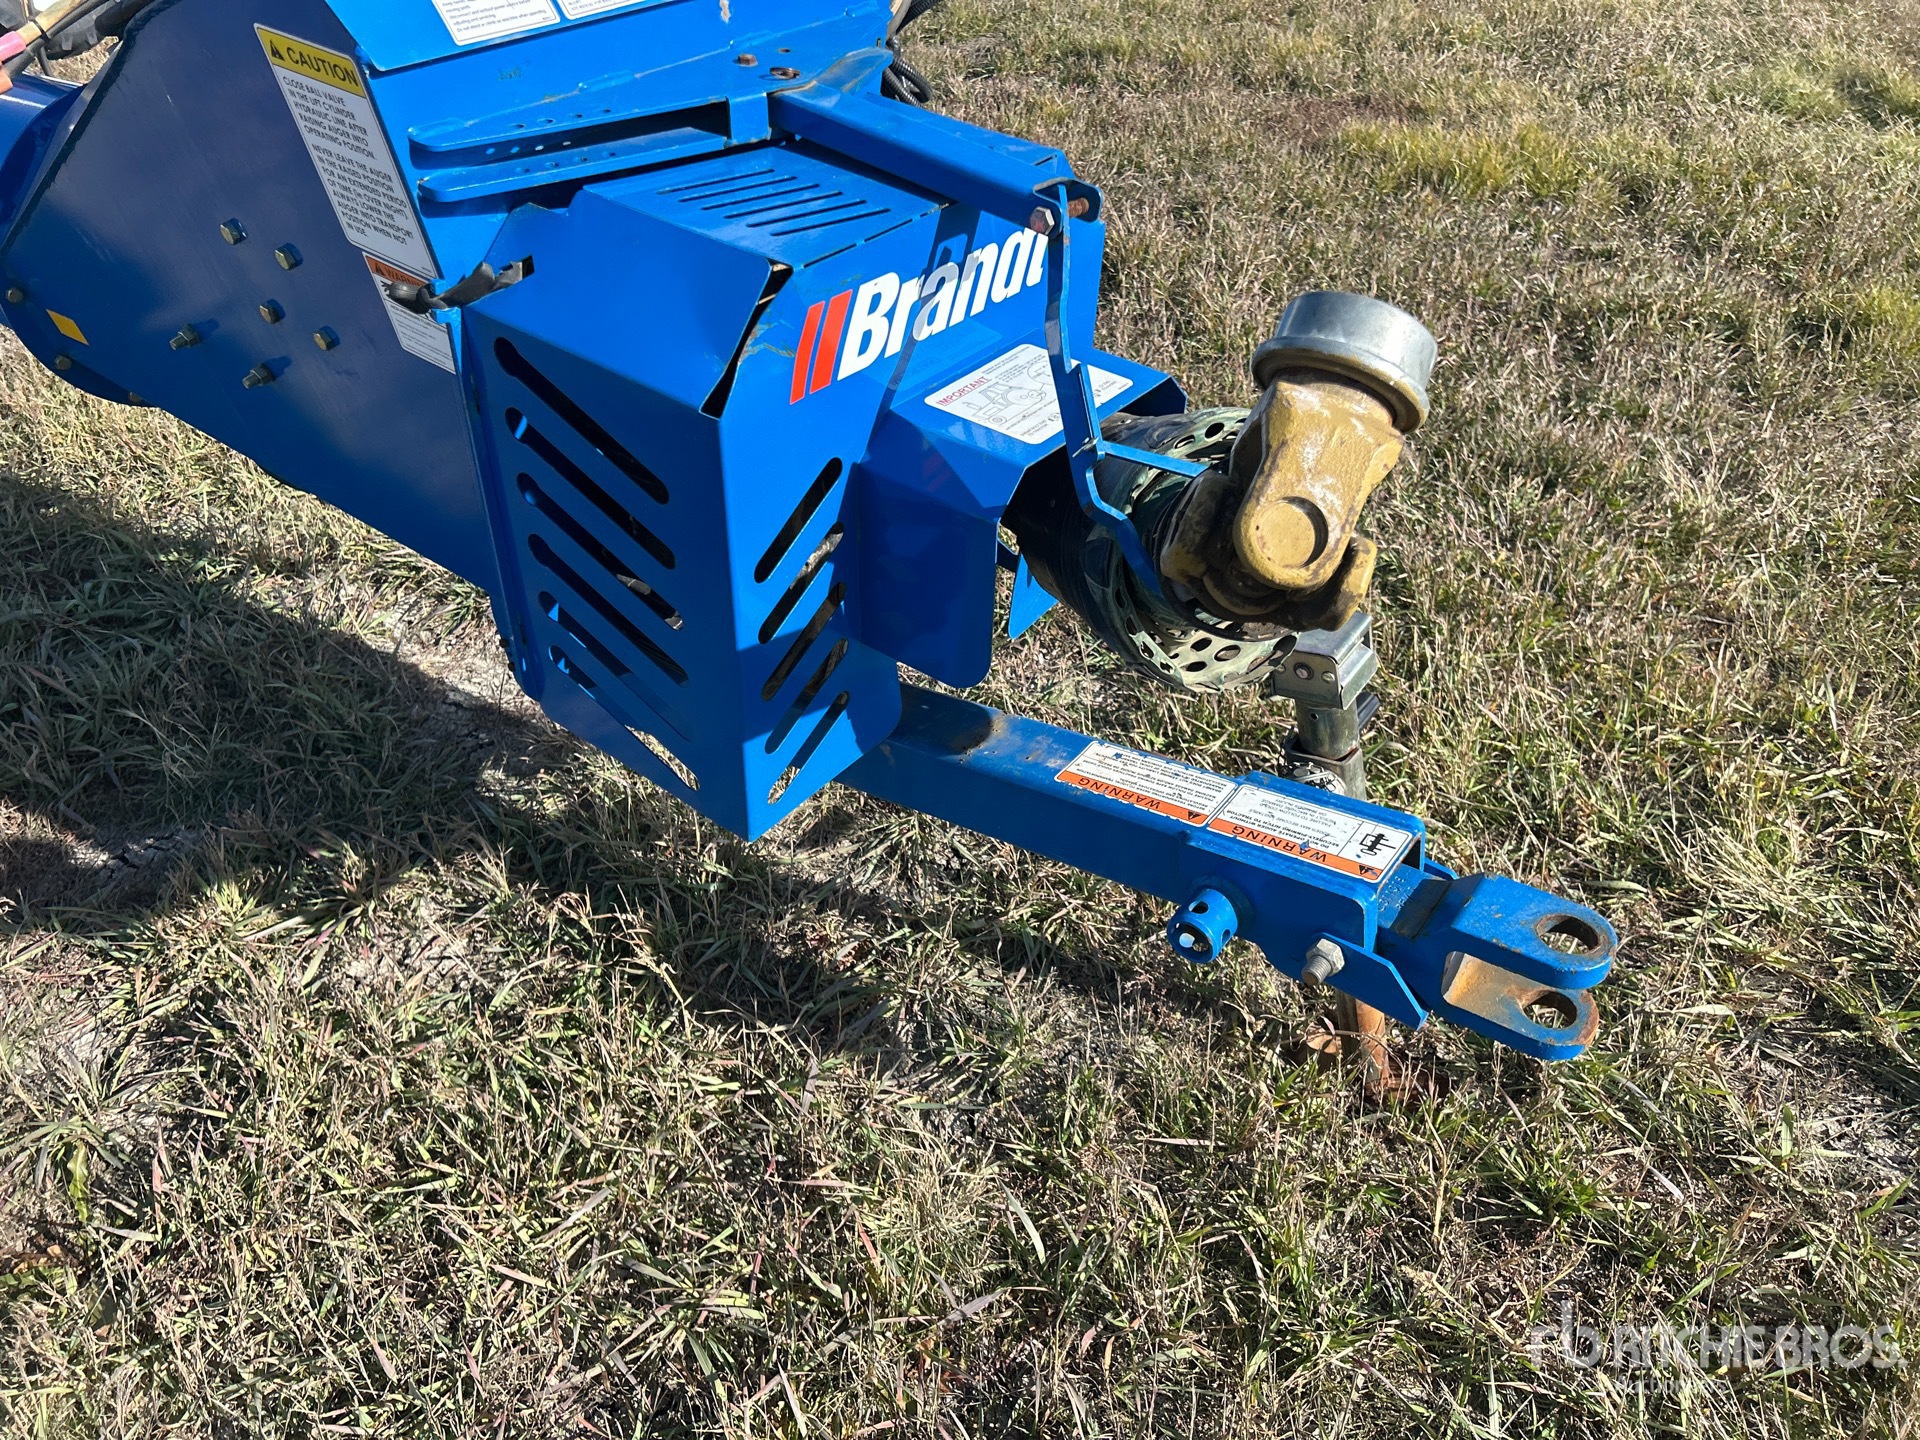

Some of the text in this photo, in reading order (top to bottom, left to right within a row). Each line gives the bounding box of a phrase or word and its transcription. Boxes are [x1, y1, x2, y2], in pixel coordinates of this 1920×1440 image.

[283, 45, 359, 87] CAUTION
[281, 75, 346, 107] CLOSE BALL VALVE
[287, 88, 356, 121] IN THE LIFT CYLINDER
[292, 100, 368, 136] HYDRAULIC LINE AFTER
[297, 112, 369, 147] RAISING AUGER INTO
[302, 123, 342, 146] OPERATING
[310, 142, 393, 183] NEVER LEAVE THE AUGER
[316, 154, 395, 193] IN THE RAISED POSITION
[321, 165, 407, 209] FOR AN EXTENDED PERIOD
[326, 177, 337, 188] OF
[336, 181, 353, 194] TIME
[362, 192, 382, 207] OVER
[331, 188, 395, 222] ALWAYS LOWER THE
[335, 199, 414, 239] AUGER INTO TRANSPORT
[340, 210, 407, 245] POSITION WHEN NOT
[344, 221, 354, 230] IN
[934, 375, 991, 405] IMPORTANT
[1076, 777, 1162, 808] WARNING
[1225, 809, 1252, 820] TRACTOR
[1229, 815, 1256, 825] WITHOUT
[1256, 823, 1277, 832] AUGER
[1261, 820, 1281, 828] HITCH
[1230, 825, 1328, 862] WARNING
[1278, 830, 1305, 841] OPERATE
